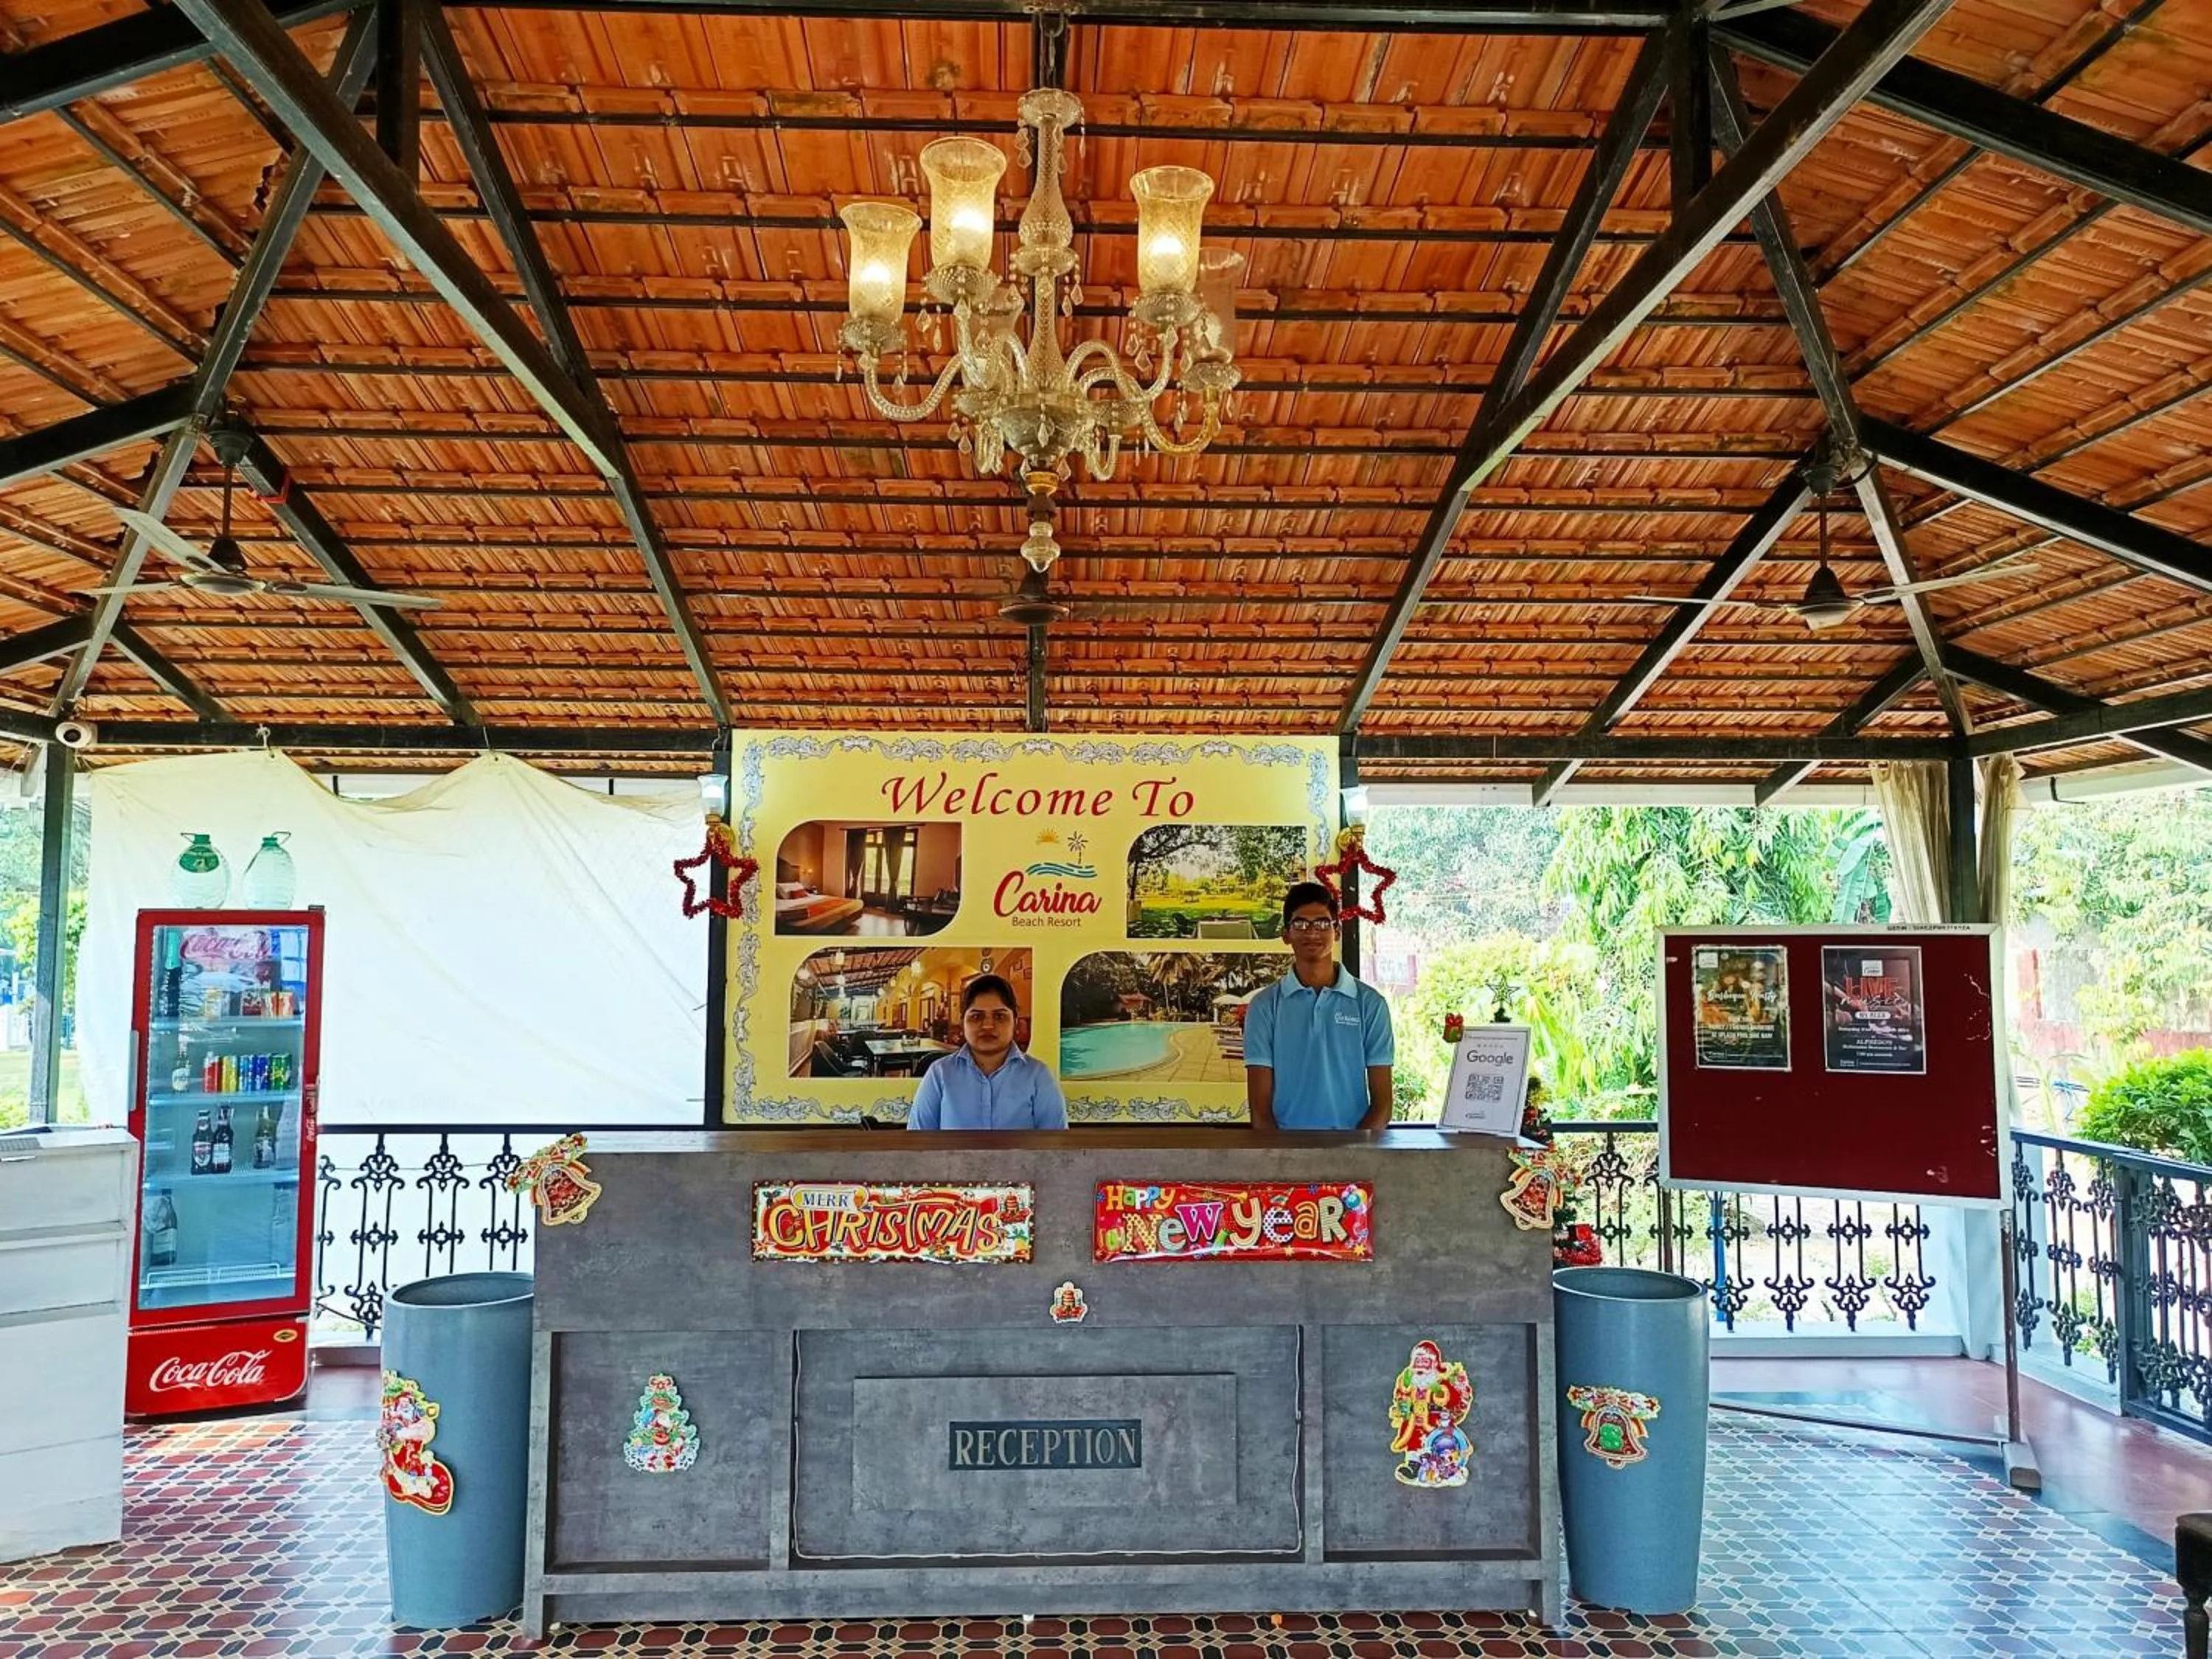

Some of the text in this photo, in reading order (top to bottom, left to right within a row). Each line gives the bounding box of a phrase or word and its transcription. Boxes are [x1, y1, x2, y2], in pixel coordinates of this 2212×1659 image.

[881, 771, 1194, 817] Welcome To
[993, 870, 1102, 918] Carina
[1012, 917, 1081, 927] Beach Resort
[1467, 1050, 1514, 1067] Google
[769, 1194, 1001, 1253] CHRISTMAS
[149, 1349, 273, 1392] Coca-Cola
[955, 1427, 1137, 1466] RECEPTION
